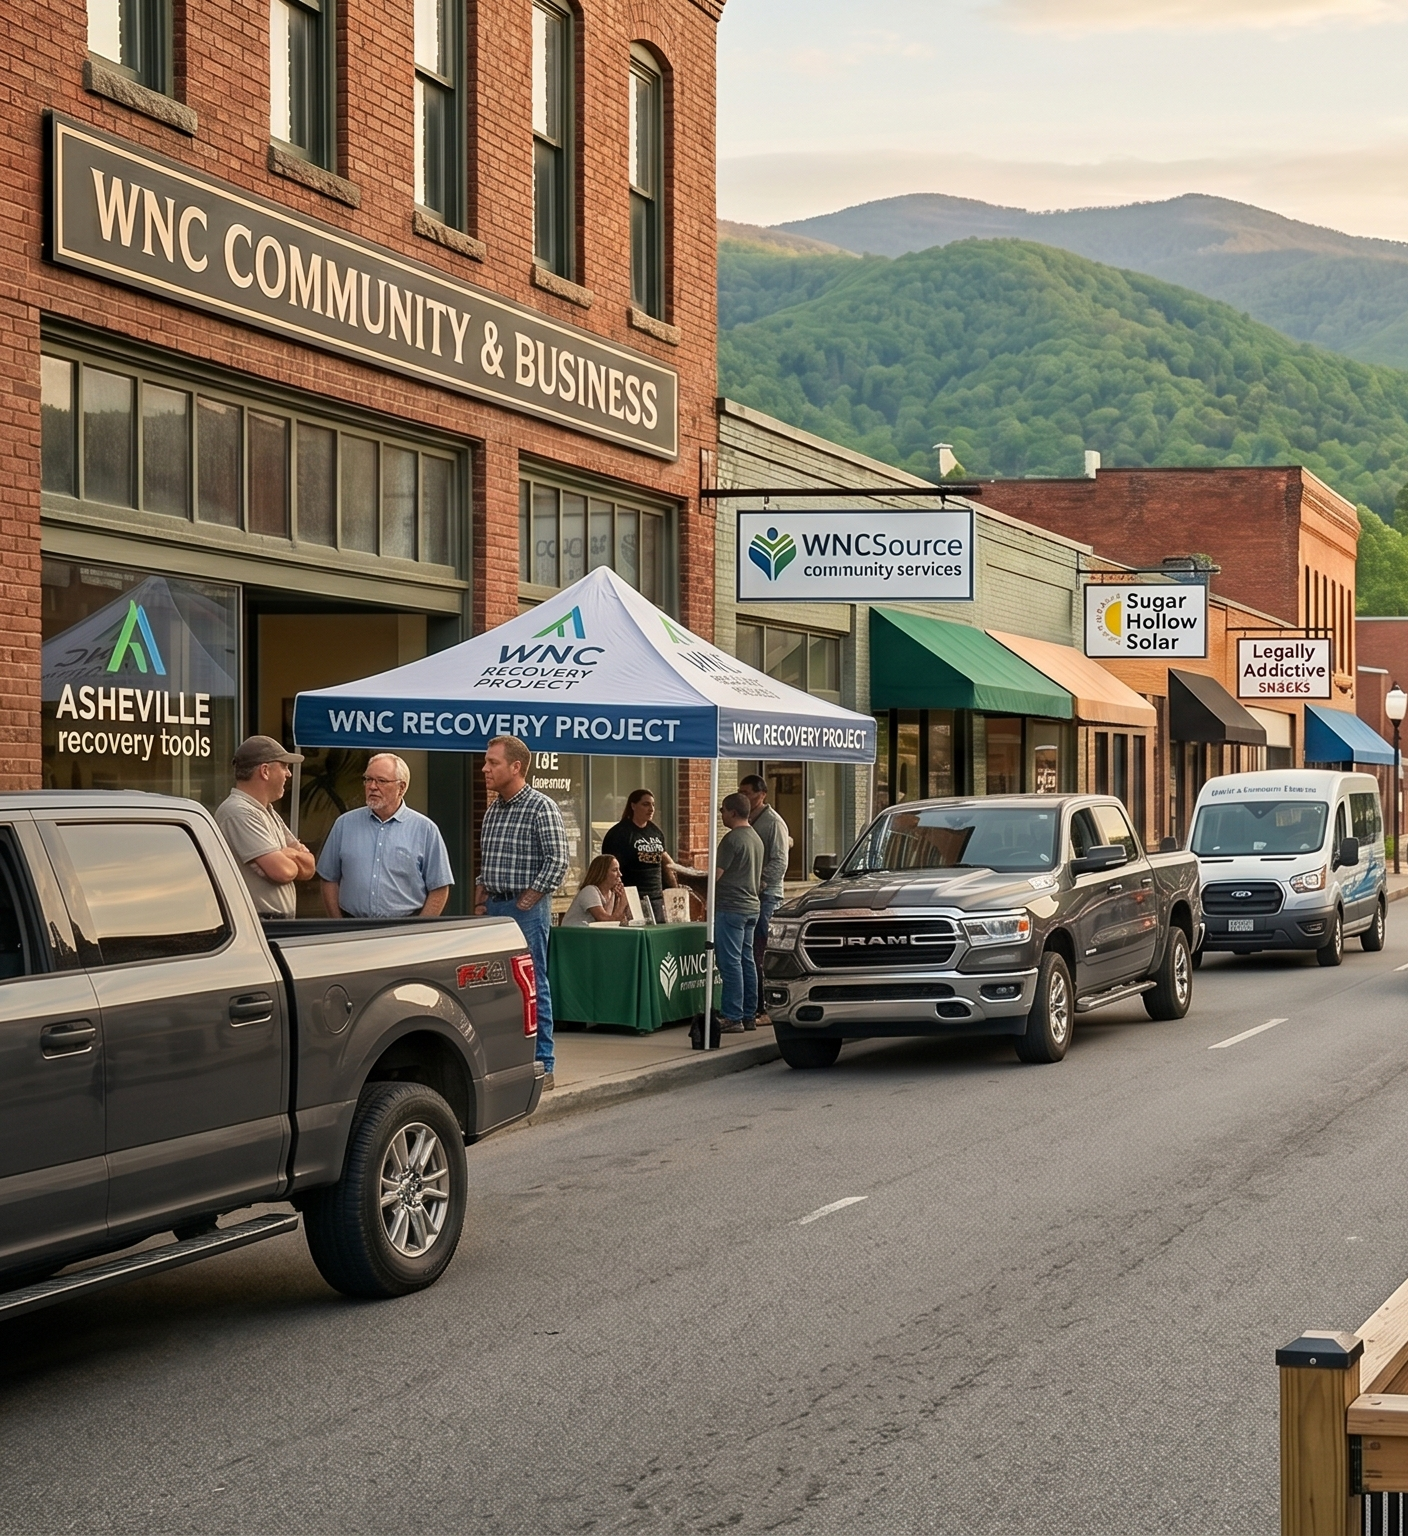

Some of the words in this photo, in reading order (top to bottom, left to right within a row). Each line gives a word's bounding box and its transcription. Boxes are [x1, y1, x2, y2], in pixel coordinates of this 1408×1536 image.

[90, 166, 209, 273] WNC
[224, 223, 472, 365] COMMUNITY
[480, 320, 506, 379] &
[514, 331, 659, 431] BUSINESS
[802, 533, 963, 557] WNCSource
[803, 561, 894, 580] community
[896, 561, 962, 577] services
[1126, 593, 1187, 612] Sugar
[1126, 613, 1198, 629] Hollow
[1126, 633, 1180, 650] Solar
[498, 644, 605, 666] WNC
[1253, 643, 1316, 662] Legally
[480, 666, 594, 679] RECOVERY
[1243, 663, 1326, 677] Addictive
[473, 678, 580, 691] PROJECT
[55, 684, 211, 725] ASHEVILLE
[328, 709, 395, 735] WNC
[402, 711, 549, 737] RECOVERY
[555, 716, 681, 742] PROJECT
[58, 728, 155, 761] recovery
[160, 728, 211, 758] tools
[732, 722, 762, 745] WNC
[763, 724, 821, 747] RECOVERY
[822, 727, 867, 749] PROJECT
[847, 935, 907, 946] RAM
